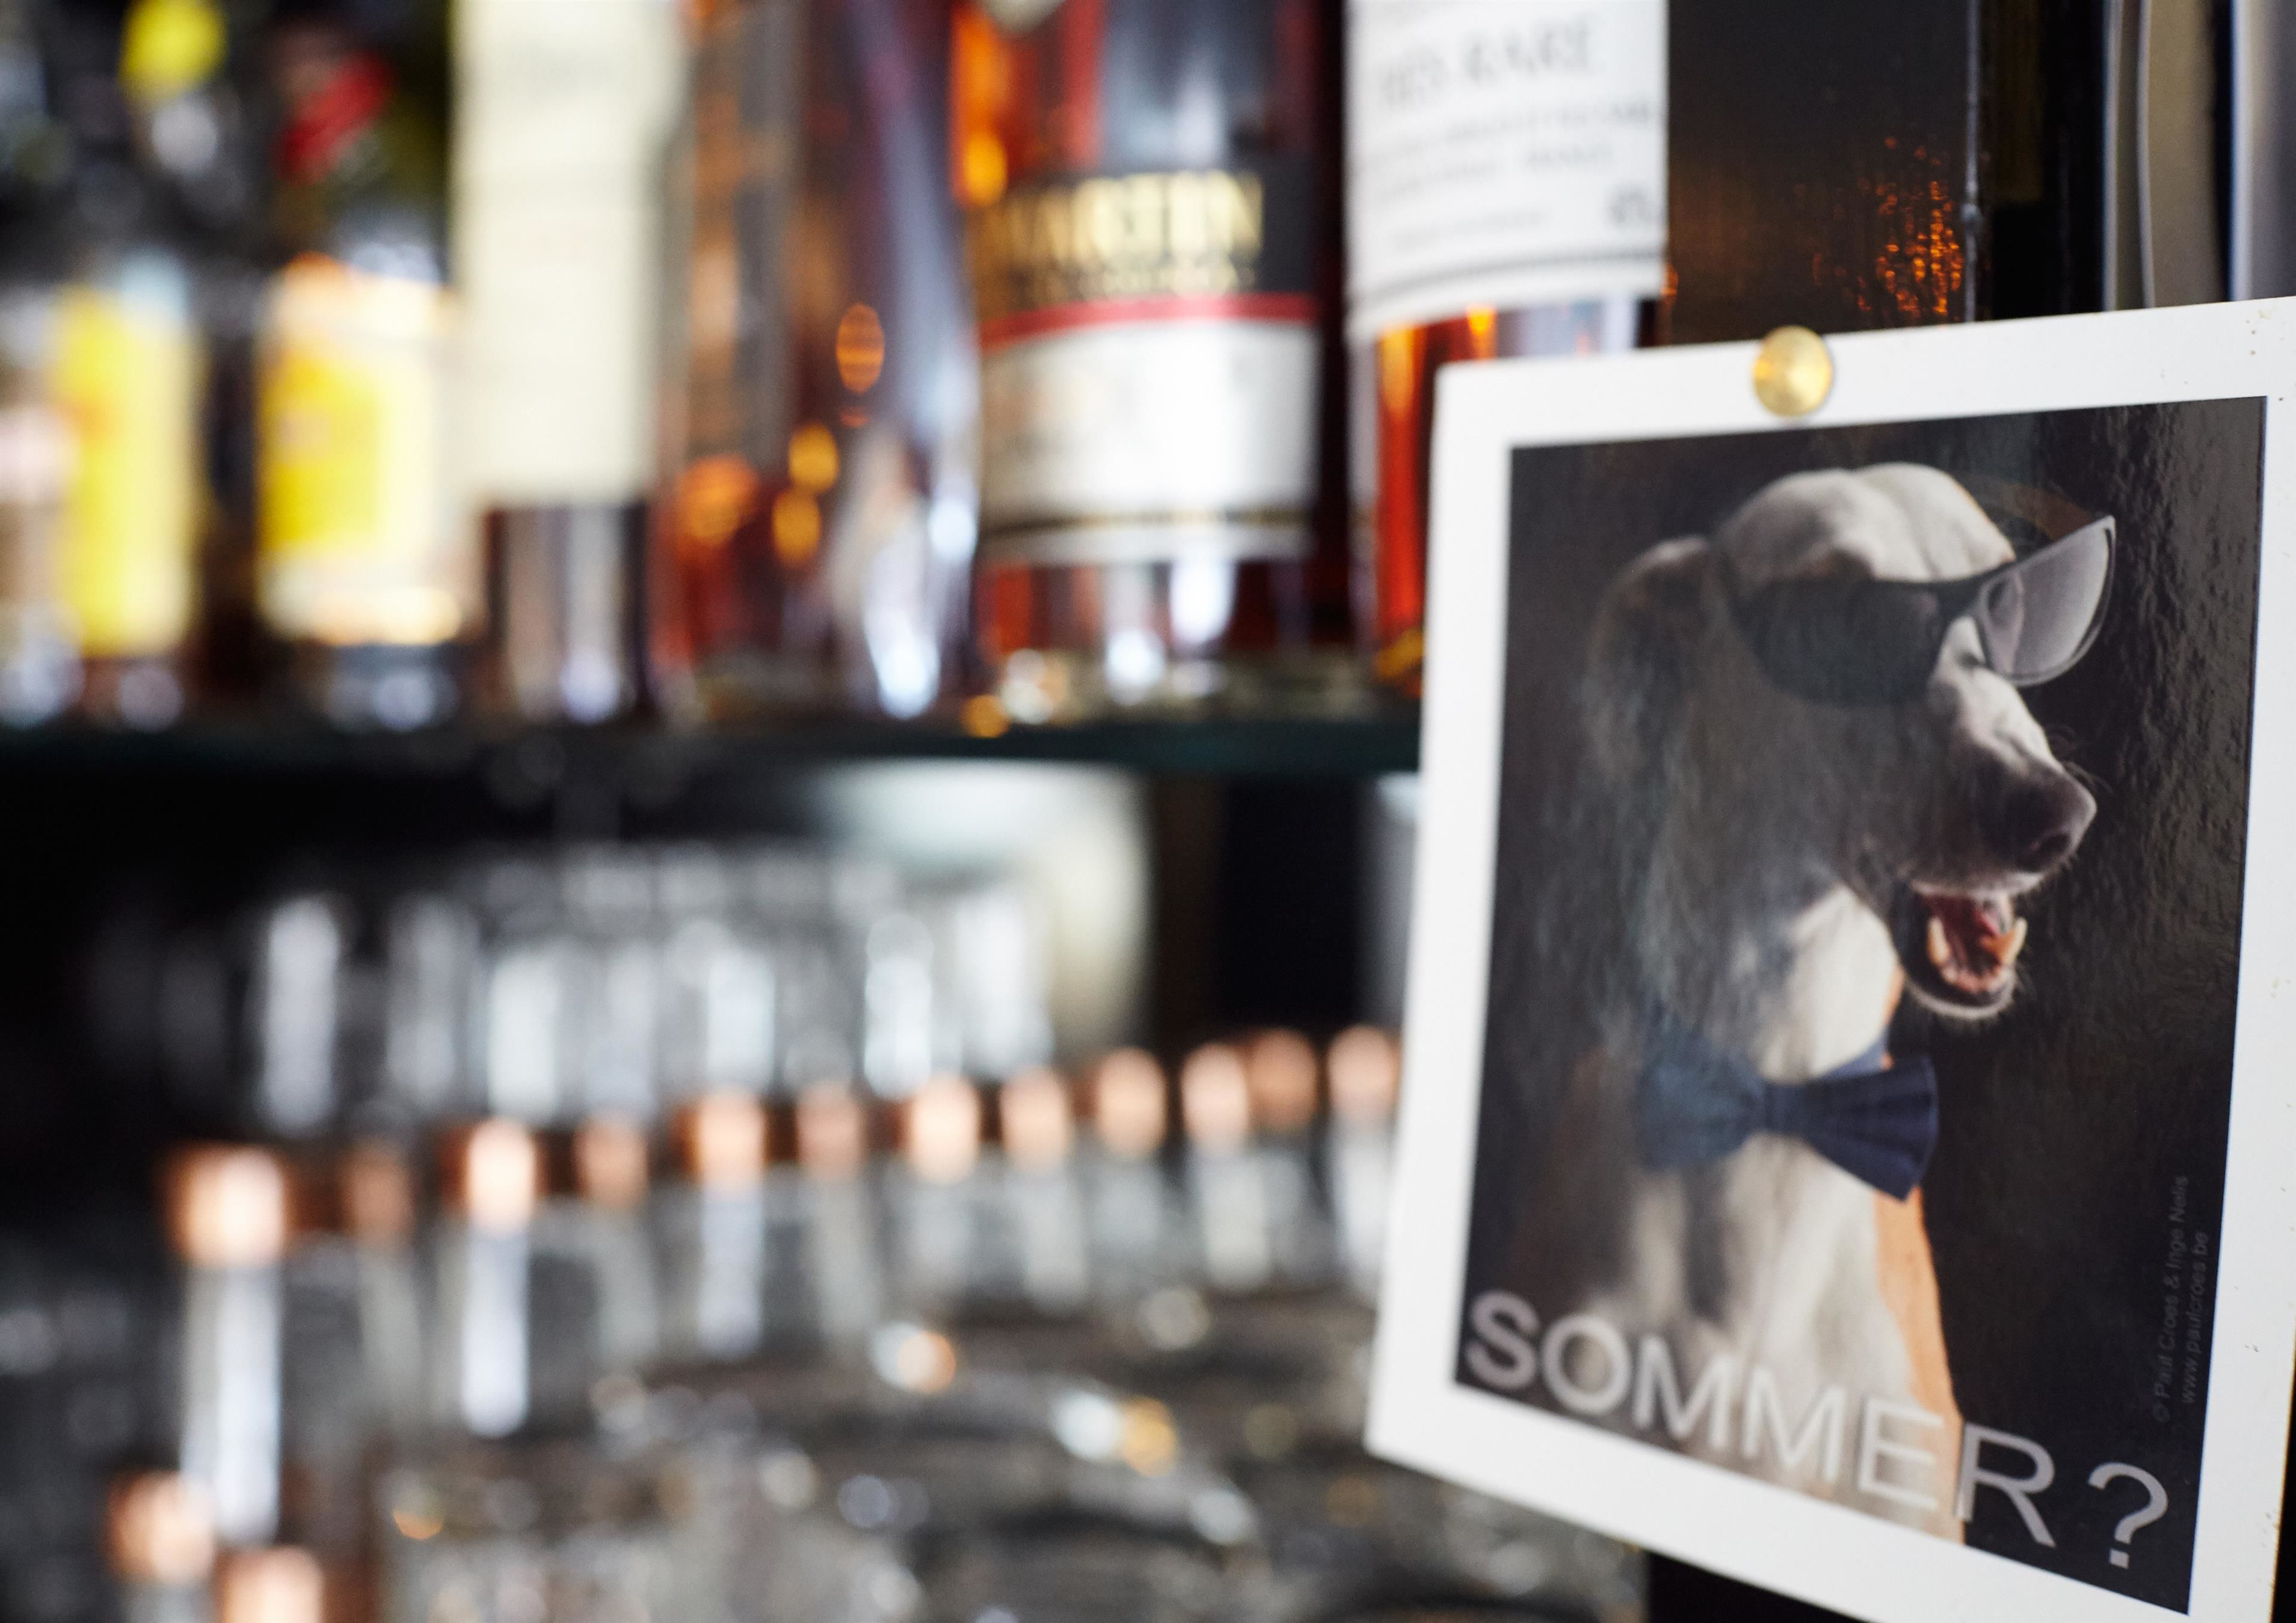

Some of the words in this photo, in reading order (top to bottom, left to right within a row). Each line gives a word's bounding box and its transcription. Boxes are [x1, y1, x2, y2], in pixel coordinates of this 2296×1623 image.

[2169, 1175, 2188, 1223] Nelis
[2166, 1228, 2187, 1269] Inge
[2163, 1274, 2180, 1289] &
[2158, 1295, 2179, 1350] Croes
[2154, 1355, 2173, 1398] Paul
